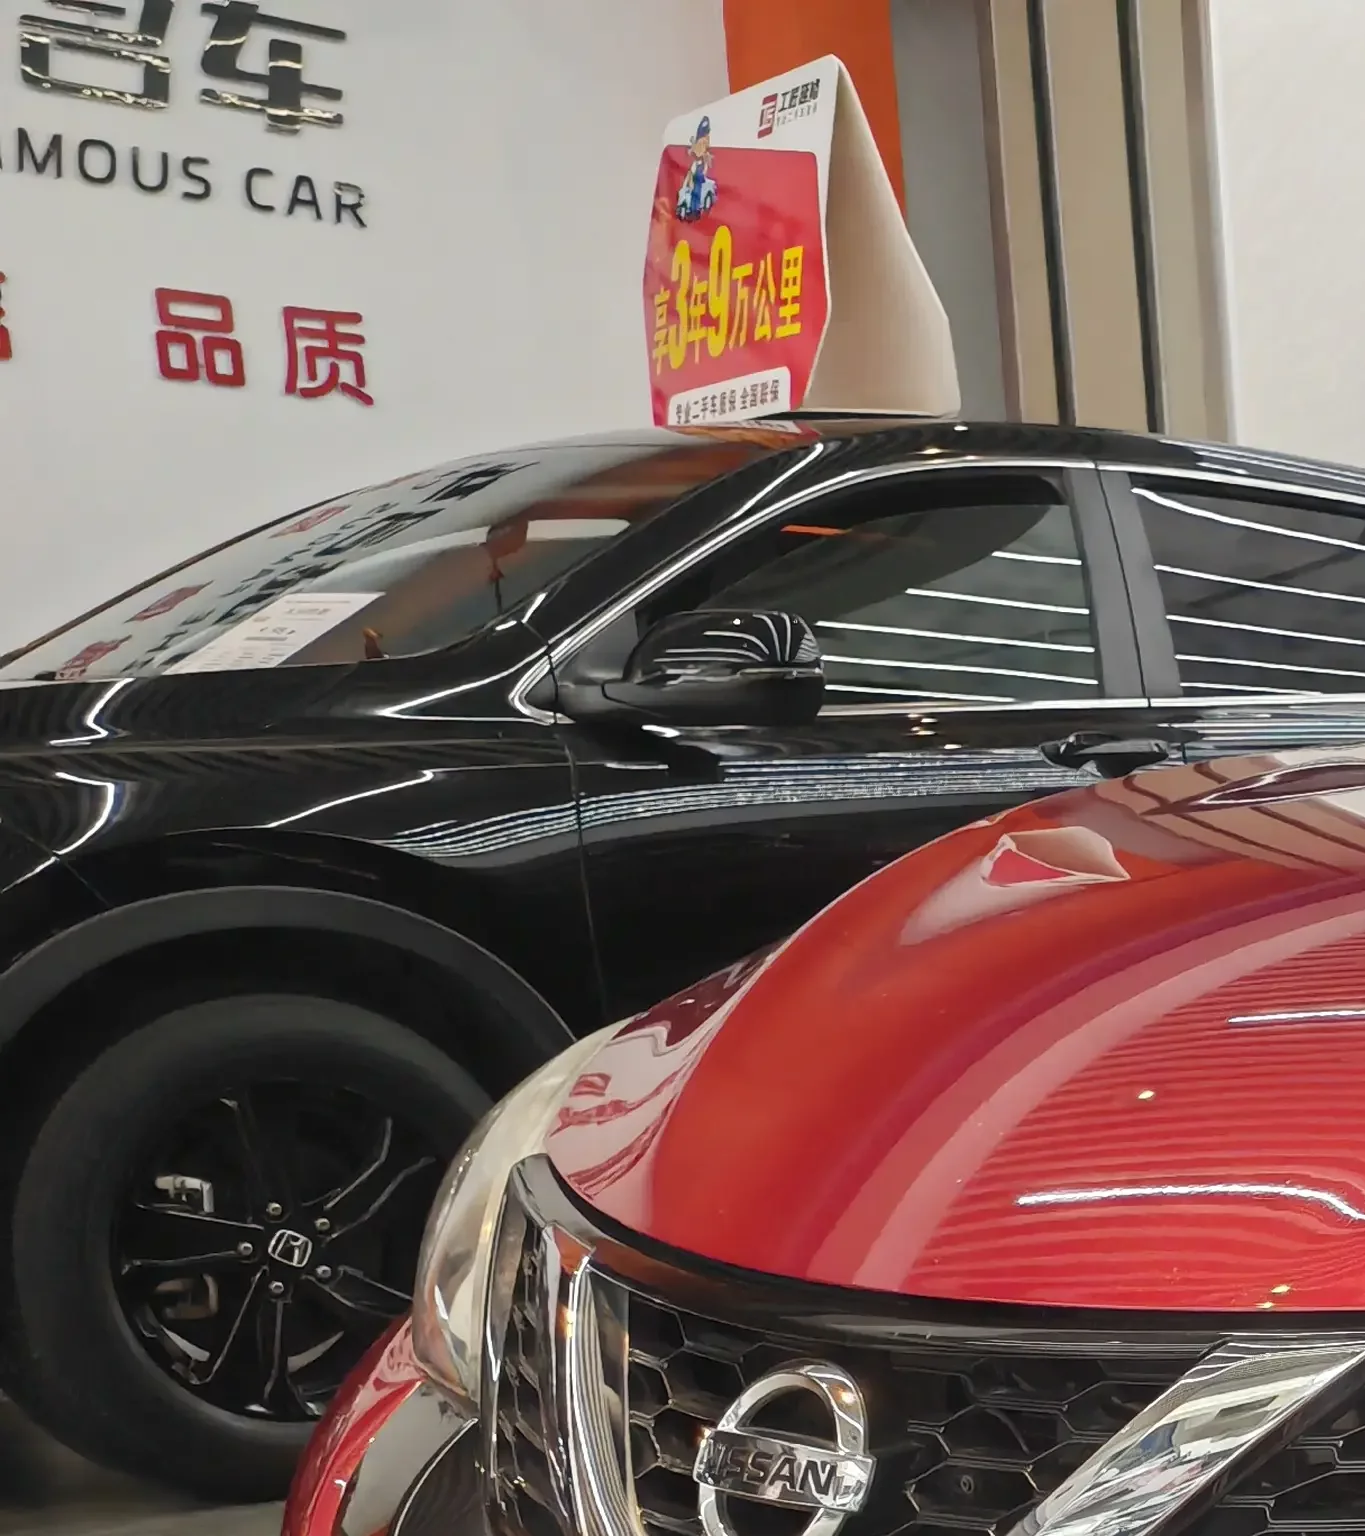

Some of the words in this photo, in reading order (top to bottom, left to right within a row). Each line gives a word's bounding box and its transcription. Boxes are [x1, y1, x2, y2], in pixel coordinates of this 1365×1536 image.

[0, 128, 212, 201] MOUS
[245, 167, 368, 228] CAR
[703, 1437, 839, 1496] NISSAN
